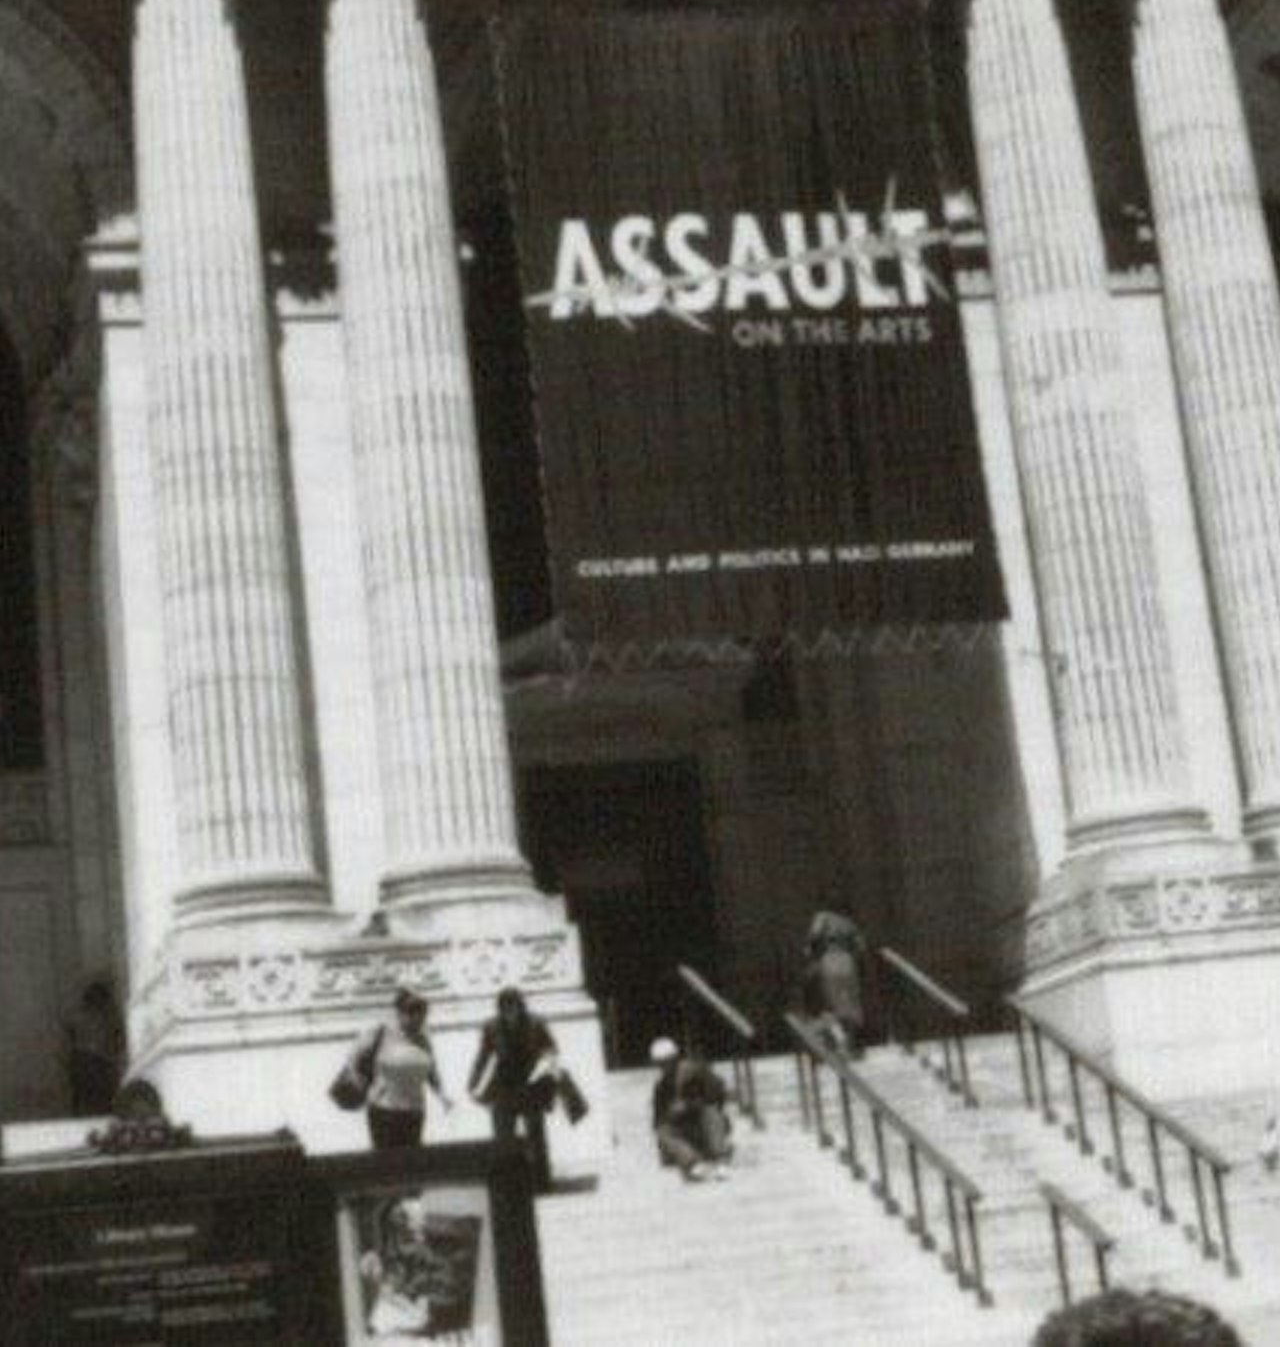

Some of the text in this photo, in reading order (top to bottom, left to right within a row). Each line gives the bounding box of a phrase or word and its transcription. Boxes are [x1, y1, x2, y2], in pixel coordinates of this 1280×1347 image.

[550, 209, 931, 320] ASSAULT
[732, 317, 932, 346] ON THE ARTS
[577, 557, 659, 577] CULTURE
[666, 553, 711, 572] AND
[718, 550, 800, 570] POLITICS
[808, 548, 831, 564] IN
[885, 540, 975, 559] GERMANY
